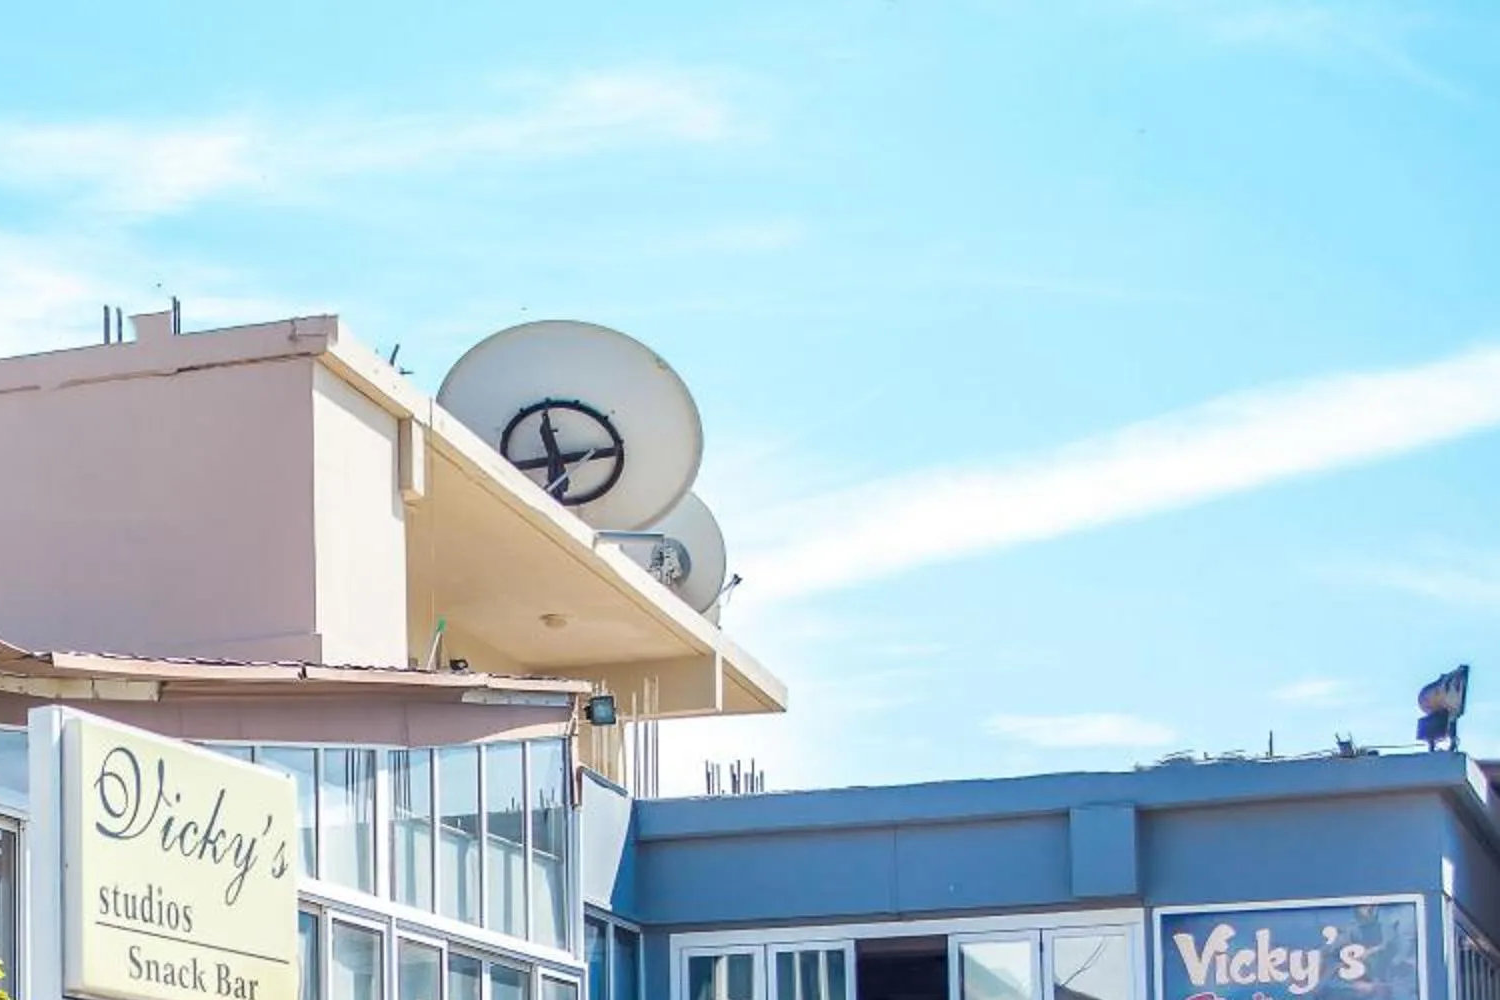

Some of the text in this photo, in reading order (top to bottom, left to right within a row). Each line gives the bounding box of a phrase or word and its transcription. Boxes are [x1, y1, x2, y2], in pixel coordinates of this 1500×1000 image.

[93, 747, 288, 906] Vicky's
[99, 883, 193, 933] studios
[128, 945, 259, 1000] Snack Bar
[1173, 924, 1366, 994] Vicky's
